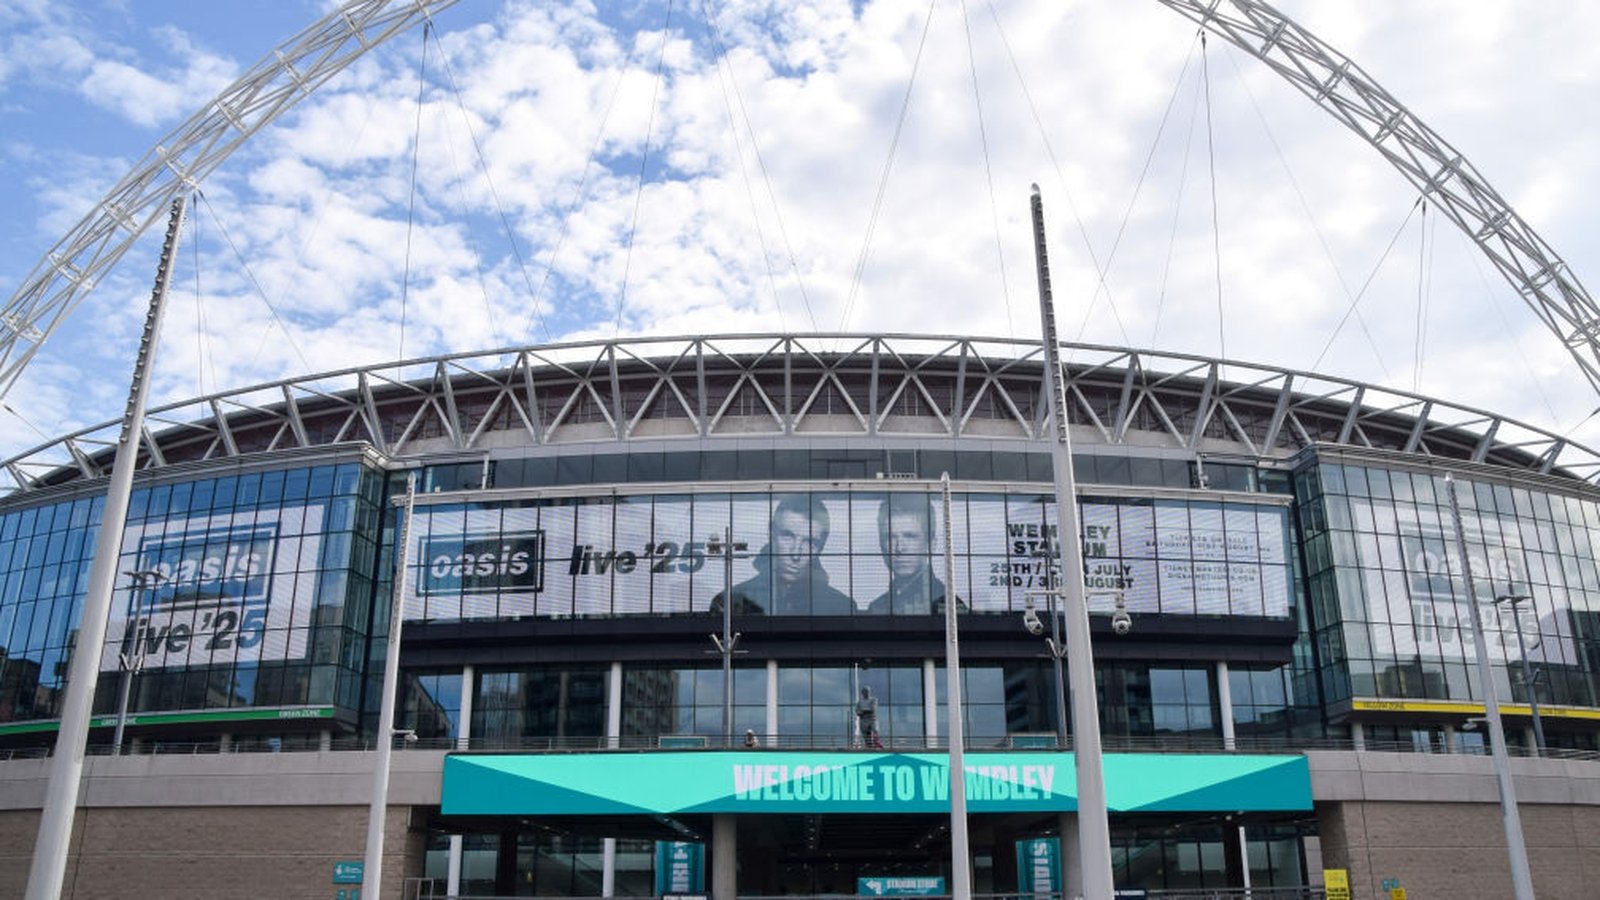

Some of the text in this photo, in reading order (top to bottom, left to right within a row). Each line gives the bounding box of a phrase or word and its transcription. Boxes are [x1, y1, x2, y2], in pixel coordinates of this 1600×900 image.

[1007, 523, 1111, 540] WEMEY
[145, 545, 261, 589] oasis
[431, 545, 529, 578] oasis
[568, 545, 637, 575] live
[1094, 565, 1132, 576] JULY
[121, 618, 191, 656] live
[733, 764, 1056, 801] WELCOME TO WMBLEY
